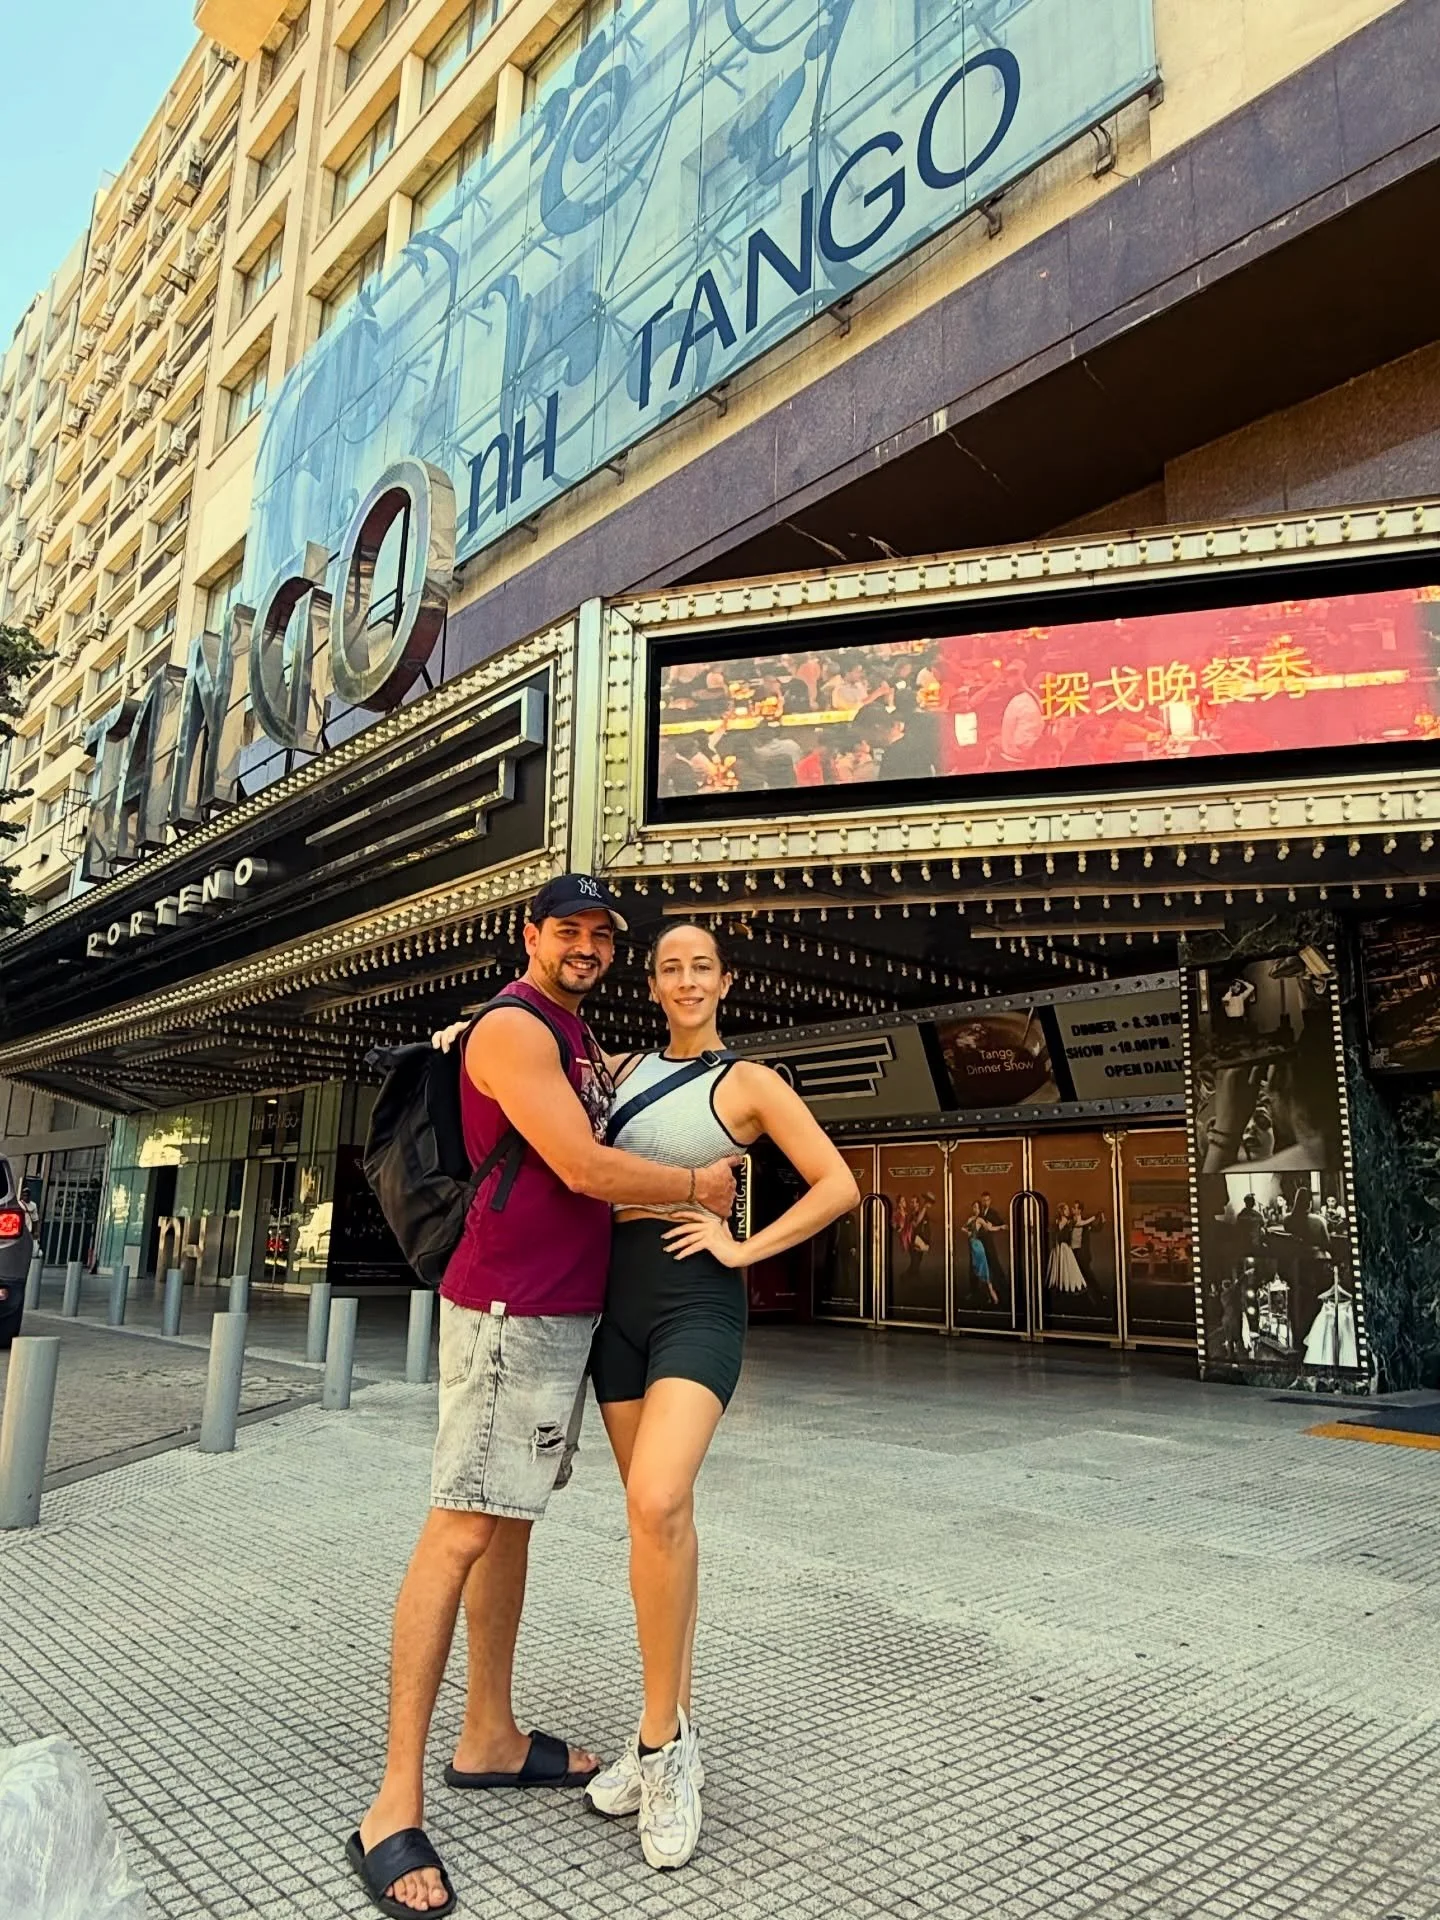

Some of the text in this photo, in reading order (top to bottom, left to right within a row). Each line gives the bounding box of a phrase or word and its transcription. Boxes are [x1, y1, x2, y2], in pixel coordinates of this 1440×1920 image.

[634, 48, 1021, 411] TANGO
[80, 458, 455, 884] TANGO
[1039, 646, 1312, 720] 探戈晚餐秀
[577, 877, 602, 898] NY
[1070, 1020, 1118, 1037] DINNER
[980, 1049, 1014, 1062] Tango
[1066, 1043, 1104, 1059] SHOW
[967, 1061, 1034, 1076] Dinner Show
[1104, 1059, 1184, 1078] OPEN DAILY
